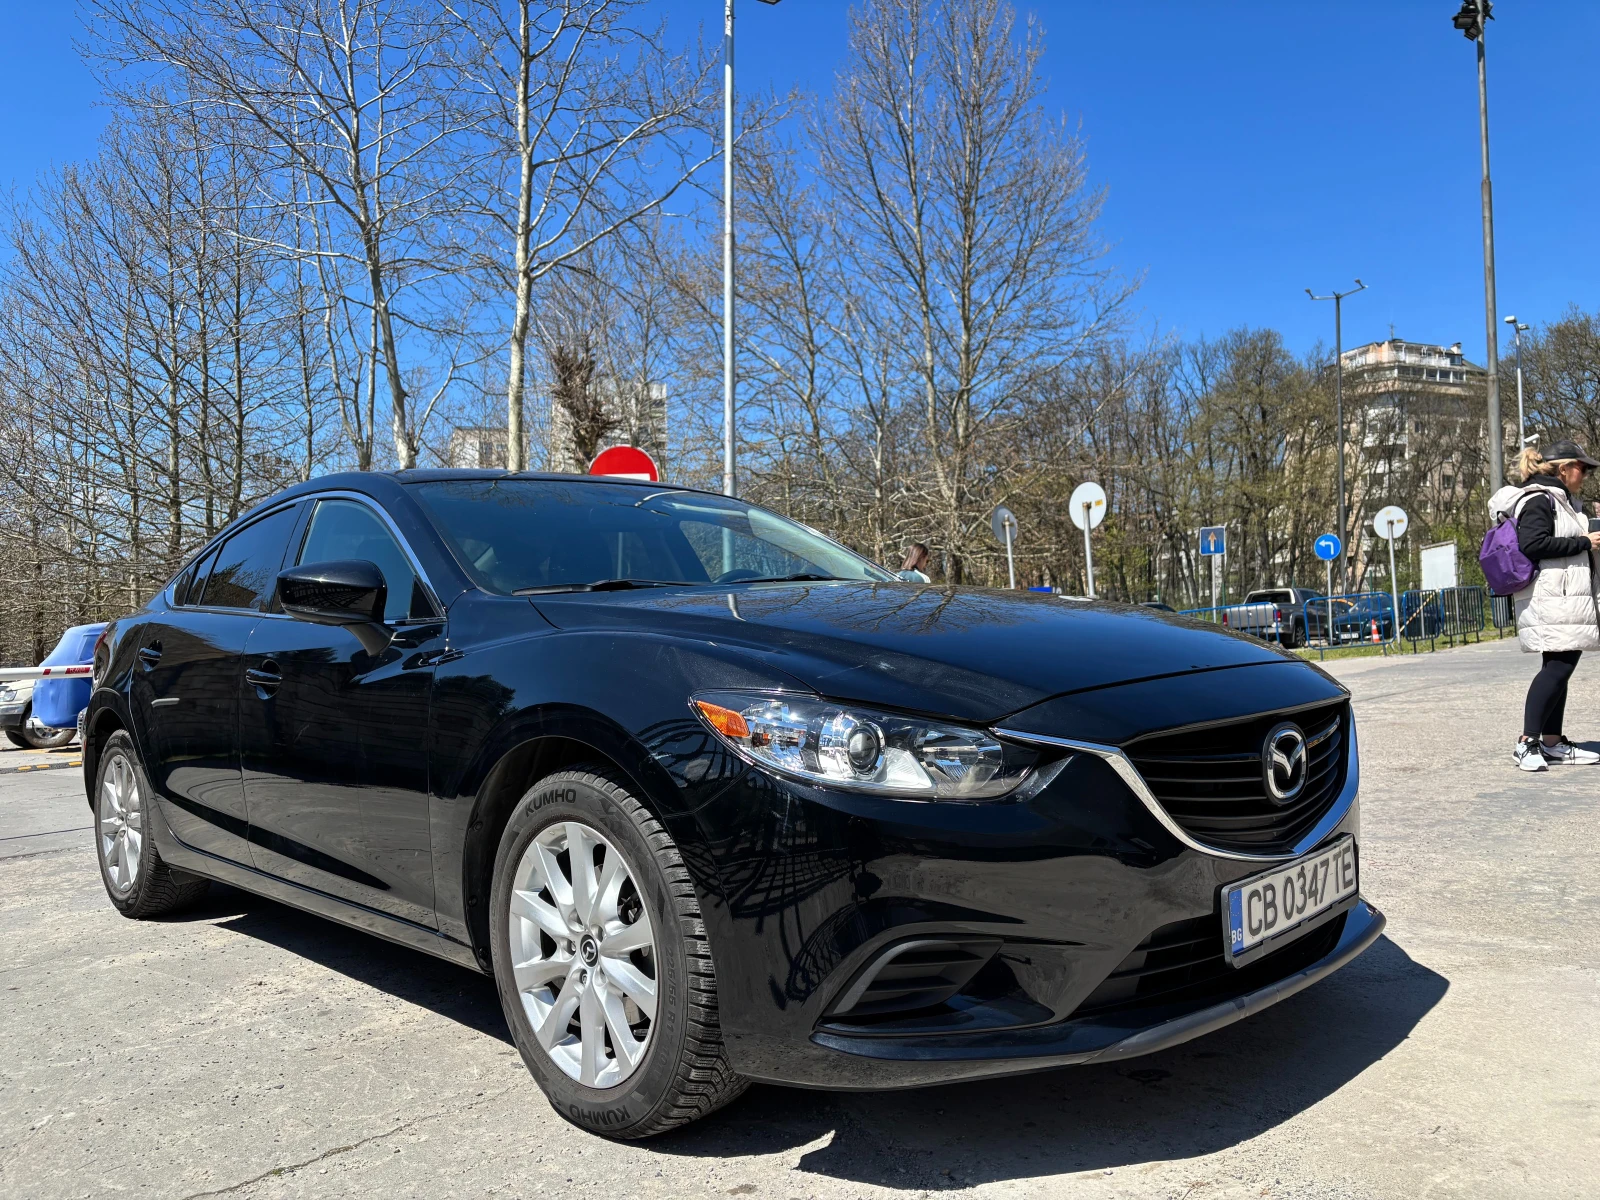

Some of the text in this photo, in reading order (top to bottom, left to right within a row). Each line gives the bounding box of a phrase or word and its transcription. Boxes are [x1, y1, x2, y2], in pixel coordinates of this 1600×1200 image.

[524, 788, 577, 817] KUMHO
[1247, 845, 1354, 937] CB 0347 TE
[1231, 927, 1243, 944] BG
[569, 1103, 631, 1126] KUMHO
